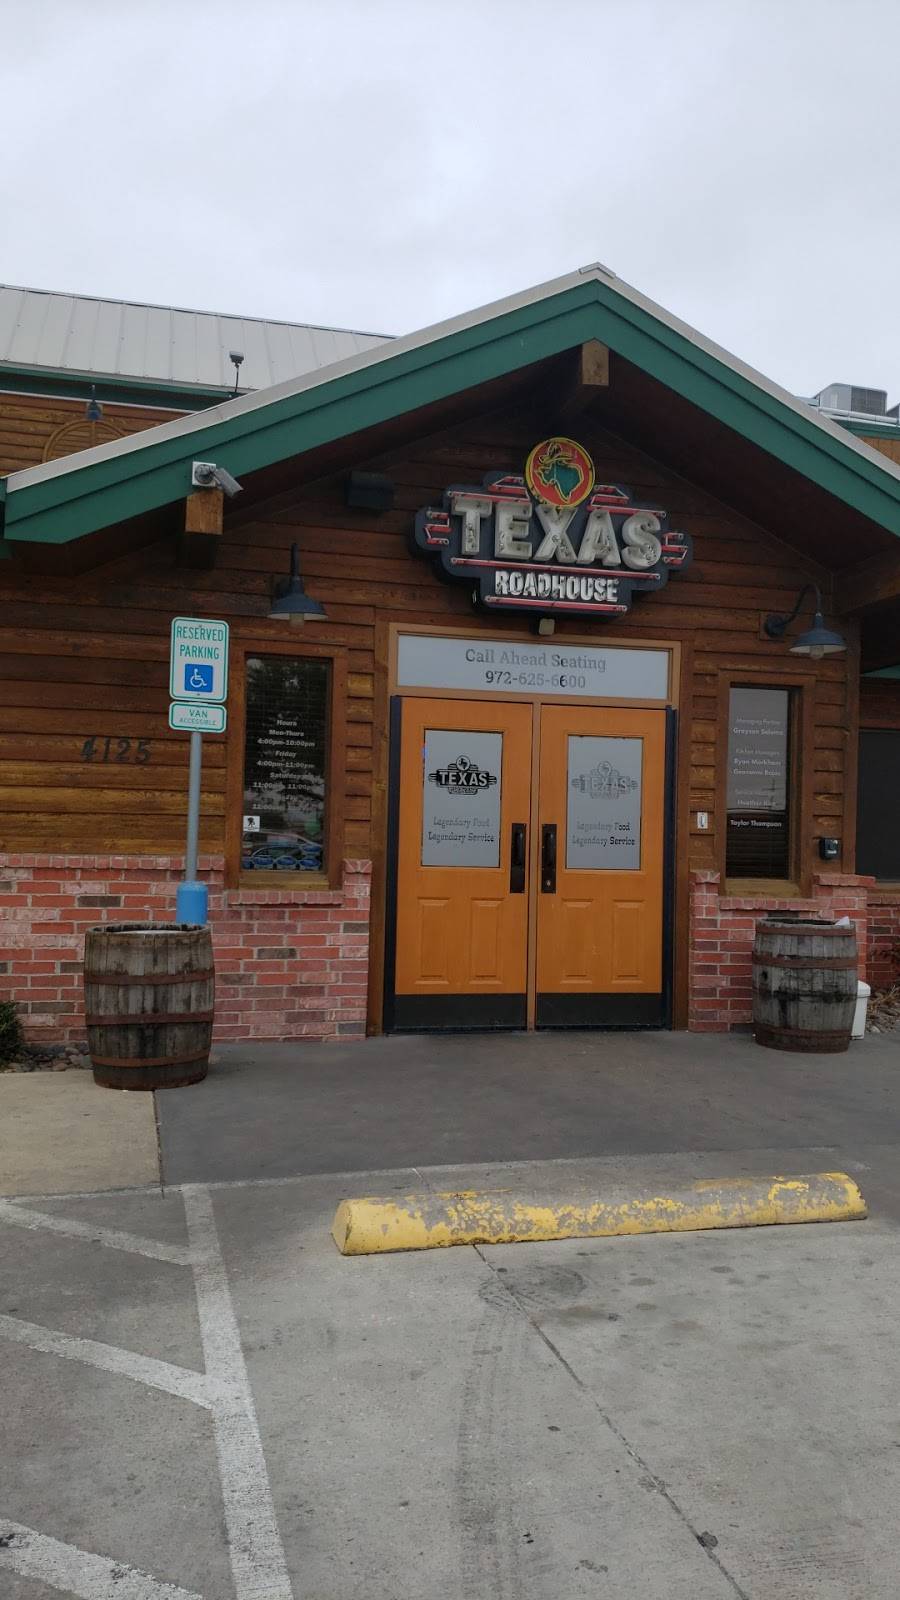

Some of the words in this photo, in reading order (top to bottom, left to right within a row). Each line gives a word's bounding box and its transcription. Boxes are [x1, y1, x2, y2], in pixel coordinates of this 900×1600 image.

[451, 497, 662, 570] TEXAS
[494, 570, 620, 603] ROADHOUSE
[176, 625, 224, 642] RESERVED
[179, 644, 220, 660] PARKING
[465, 648, 495, 664] Call
[499, 650, 547, 667] Ahead
[551, 653, 607, 673] Seating
[485, 670, 586, 689] 972-625-6600
[188, 709, 208, 719] VAN
[179, 717, 217, 726] ACCESSIBLE
[276, 719, 298, 727] Hours
[81, 736, 152, 764] 4125
[274, 750, 297, 759] Friday
[439, 771, 488, 787] TEXAS
[614, 821, 631, 831] Food
[730, 819, 750, 827] Taylor
[750, 819, 782, 828] Thompson
[428, 831, 466, 844] Legendary
[467, 832, 495, 843] Service
[572, 834, 608, 847] Legendary
[609, 836, 636, 846] Service
